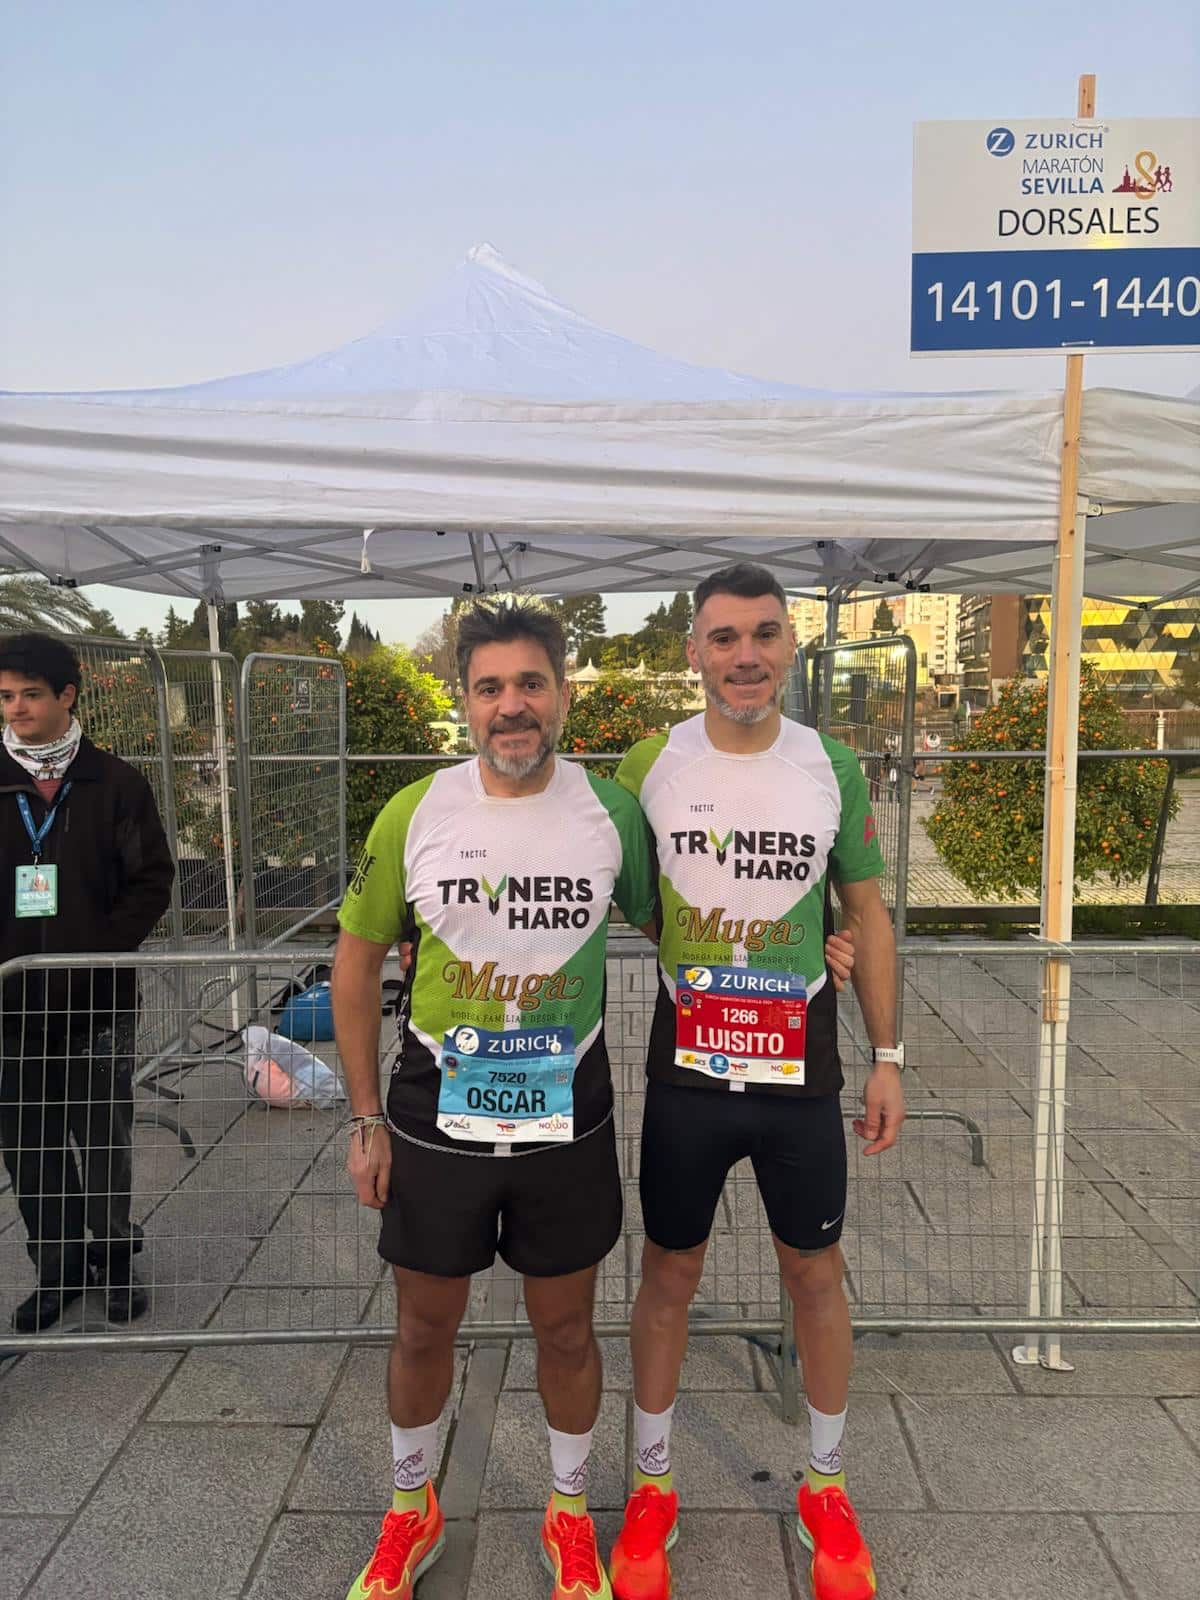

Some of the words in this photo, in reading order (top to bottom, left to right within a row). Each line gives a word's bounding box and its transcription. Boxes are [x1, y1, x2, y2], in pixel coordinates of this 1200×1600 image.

[1024, 132, 1104, 150] ZURICH
[1022, 154, 1104, 175] MARATÓN
[1021, 177, 1105, 195] SEVILLA
[998, 206, 1160, 237] DORSALES
[460, 849, 487, 859] TACTIC
[734, 859, 810, 881] HARO
[508, 907, 590, 930] HARO
[676, 906, 805, 952] Muga
[442, 960, 585, 1010] Muga
[719, 973, 790, 993] ZURICH
[721, 1008, 759, 1025] 1266
[487, 1033, 559, 1054] ZURICH
[696, 1025, 785, 1055] LUISITO
[488, 1071, 527, 1085] 7520
[466, 1087, 546, 1114] OSCAR
